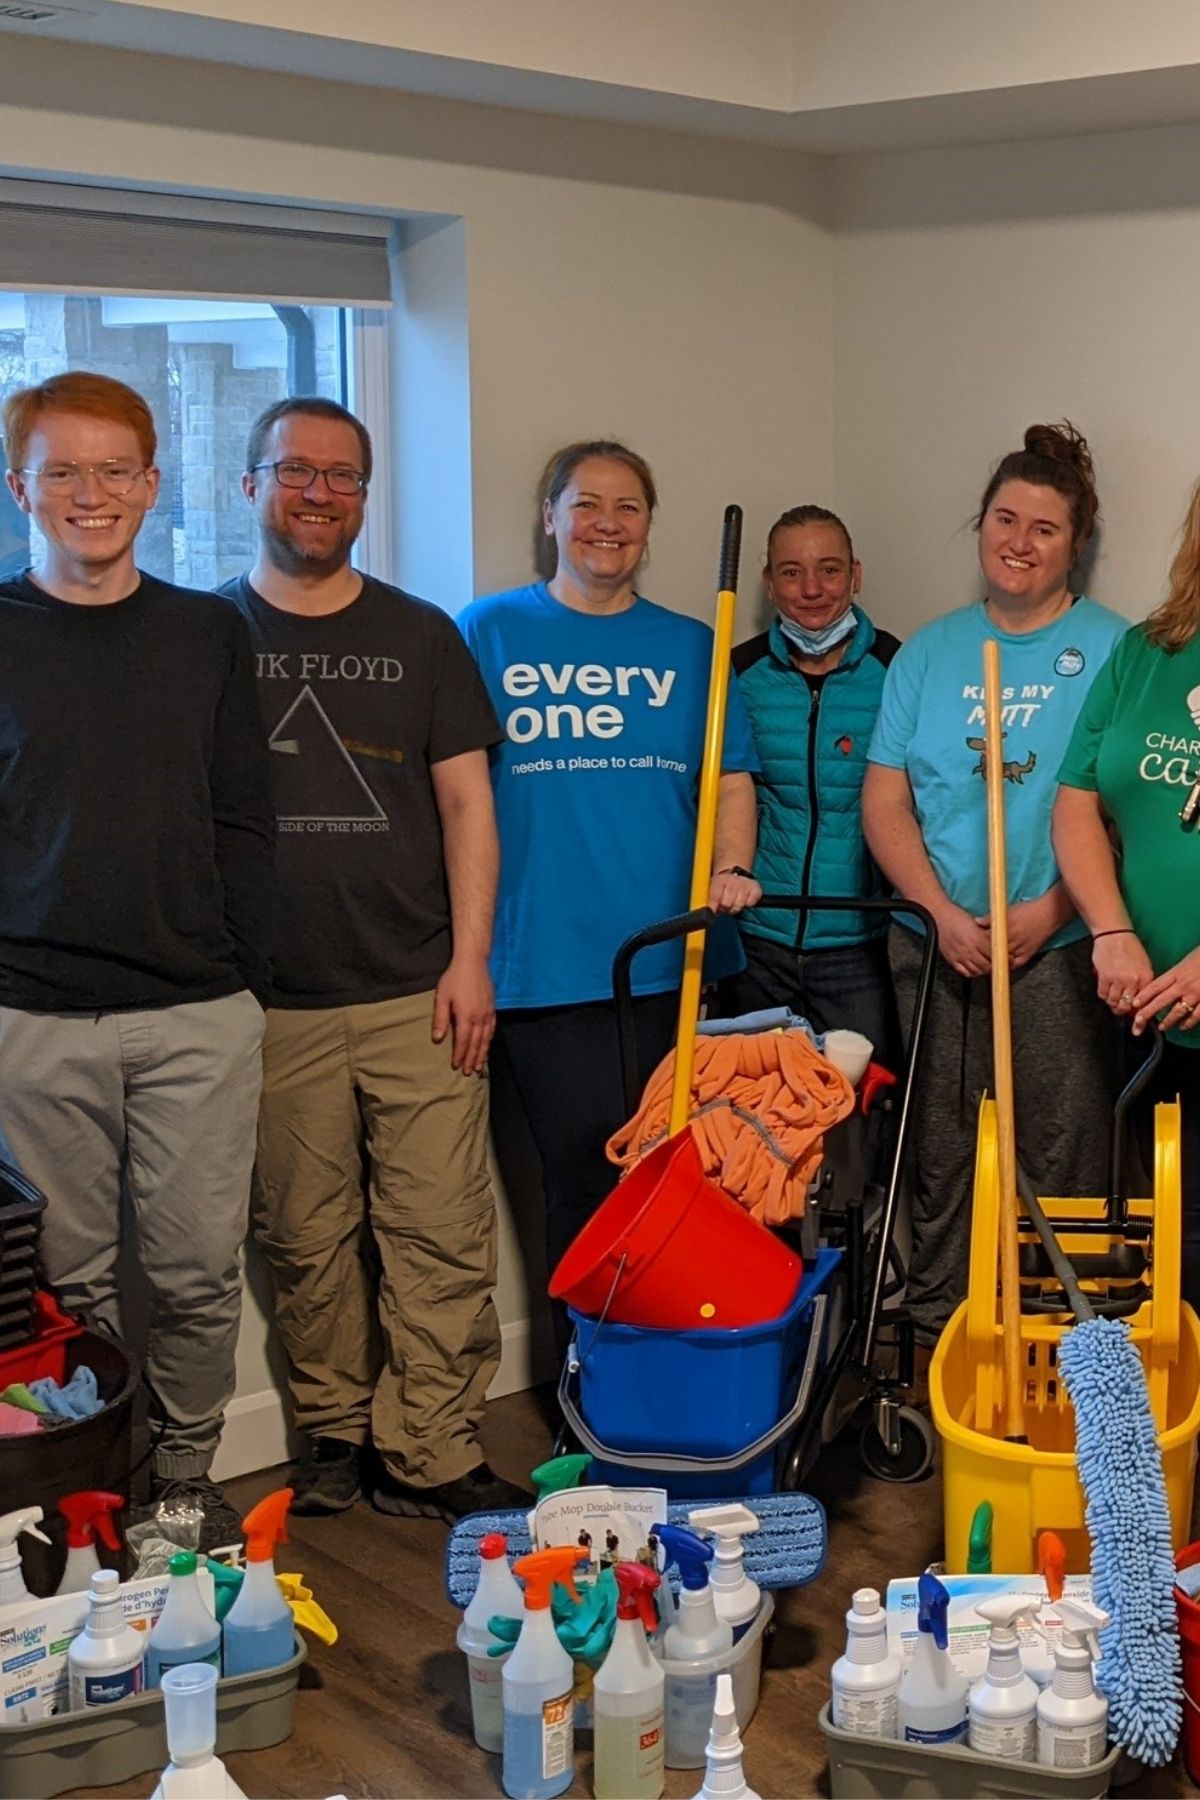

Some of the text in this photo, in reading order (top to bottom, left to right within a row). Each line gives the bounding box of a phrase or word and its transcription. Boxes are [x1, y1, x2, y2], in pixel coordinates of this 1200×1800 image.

[300, 654, 404, 682] FLOYD
[502, 663, 676, 707] every
[962, 684, 1055, 700] KIS MY
[506, 704, 624, 744] one
[511, 755, 687, 775] needs a place to call home
[278, 822, 390, 833] SIDE OF THE MOON
[560, 1504, 584, 1515] Mop
[586, 1502, 622, 1513] Double
[624, 1502, 654, 1513] Bucket
